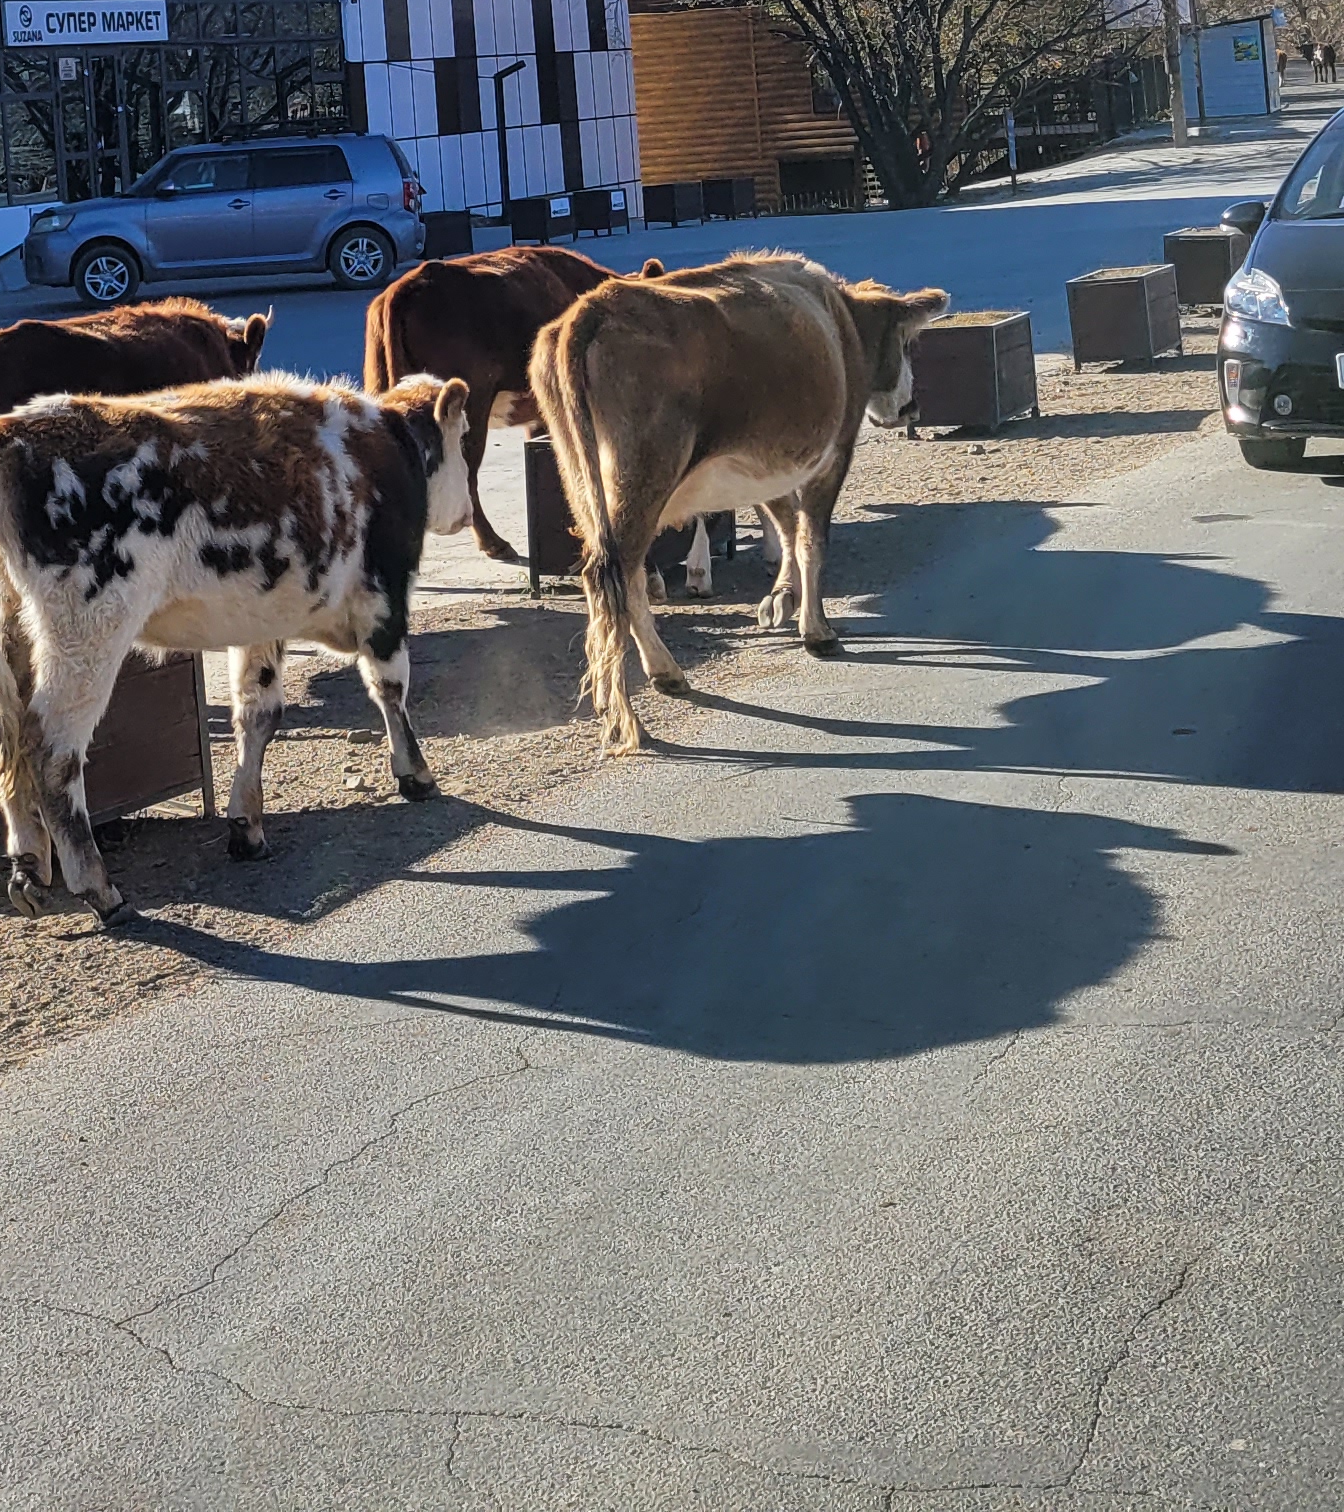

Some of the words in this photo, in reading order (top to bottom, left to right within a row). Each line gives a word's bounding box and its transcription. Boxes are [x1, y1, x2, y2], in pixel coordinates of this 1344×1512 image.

[45, 11, 96, 33] СУПЕР
[102, 10, 160, 32] МАРКЕТ
[12, 29, 43, 42] SUZANA
